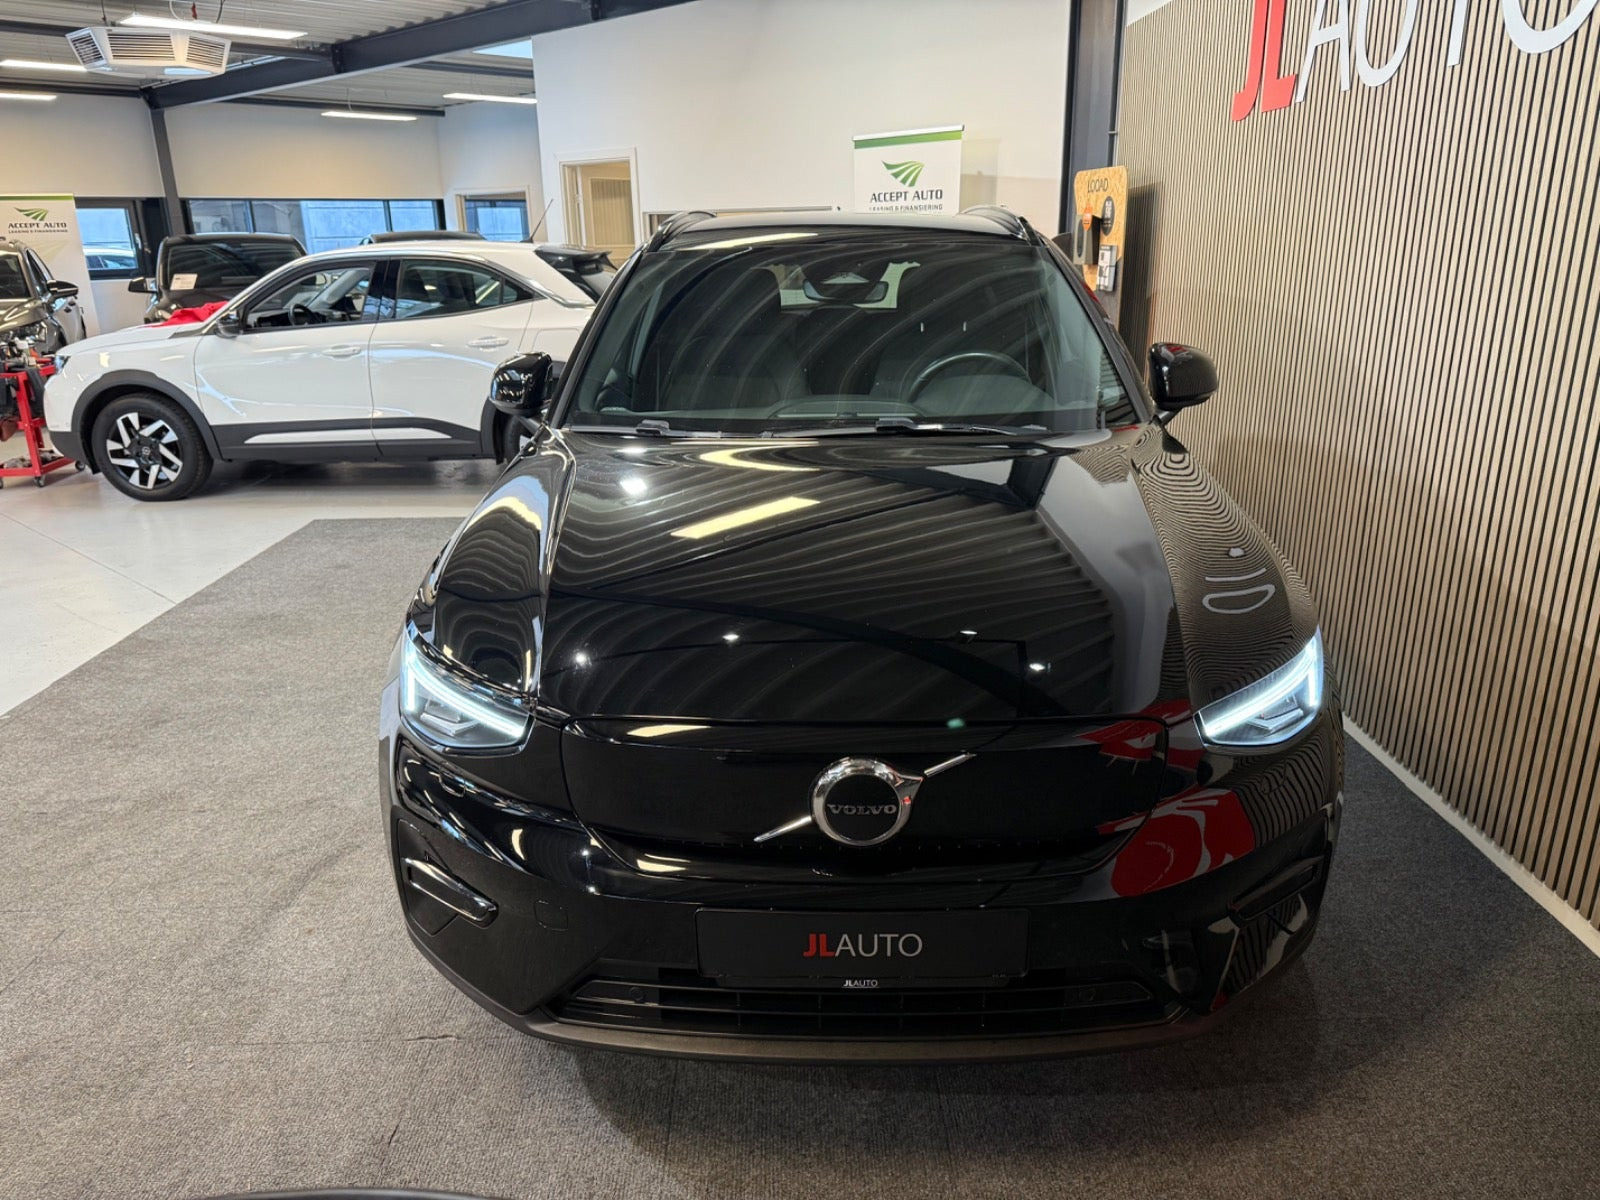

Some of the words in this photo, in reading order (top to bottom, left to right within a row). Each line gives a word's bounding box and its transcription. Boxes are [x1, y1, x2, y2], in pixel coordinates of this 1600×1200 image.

[870, 190, 909, 203] ACCEPT
[912, 189, 943, 201] AUTO
[827, 804, 897, 815] VOLVO
[803, 933, 923, 957] JLAUTO
[843, 979, 879, 987] JLAUTO
